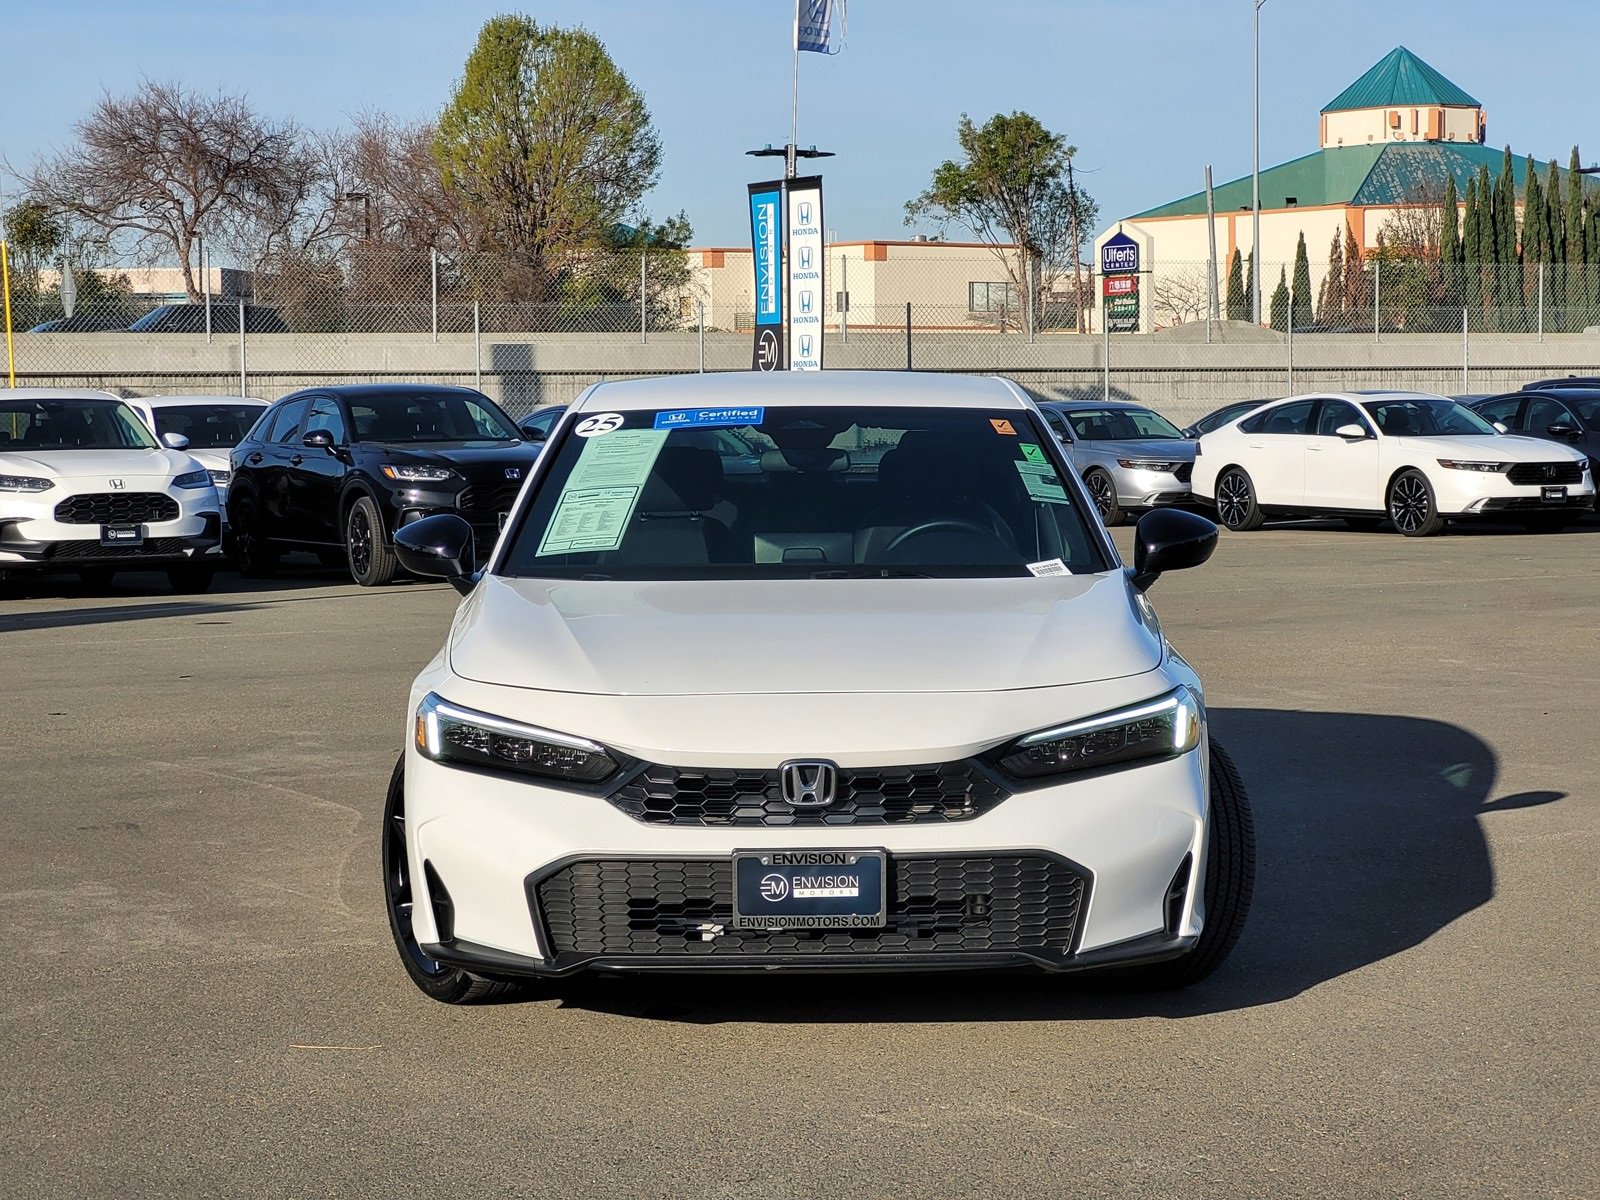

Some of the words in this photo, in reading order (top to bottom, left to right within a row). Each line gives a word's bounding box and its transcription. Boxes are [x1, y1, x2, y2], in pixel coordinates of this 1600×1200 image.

[792, 227, 819, 236] HONDA
[757, 203, 769, 315] ENVISION
[1104, 247, 1135, 262] Ulferts
[792, 272, 819, 280] HONDA
[793, 316, 819, 324] HONDA
[793, 360, 818, 368] HONDA
[699, 409, 758, 418] Certified
[578, 416, 621, 433] 25
[772, 853, 846, 865] ENVISION
[792, 876, 859, 889] ENVISION
[739, 916, 880, 927] ENVISIONMOTORS.COM
